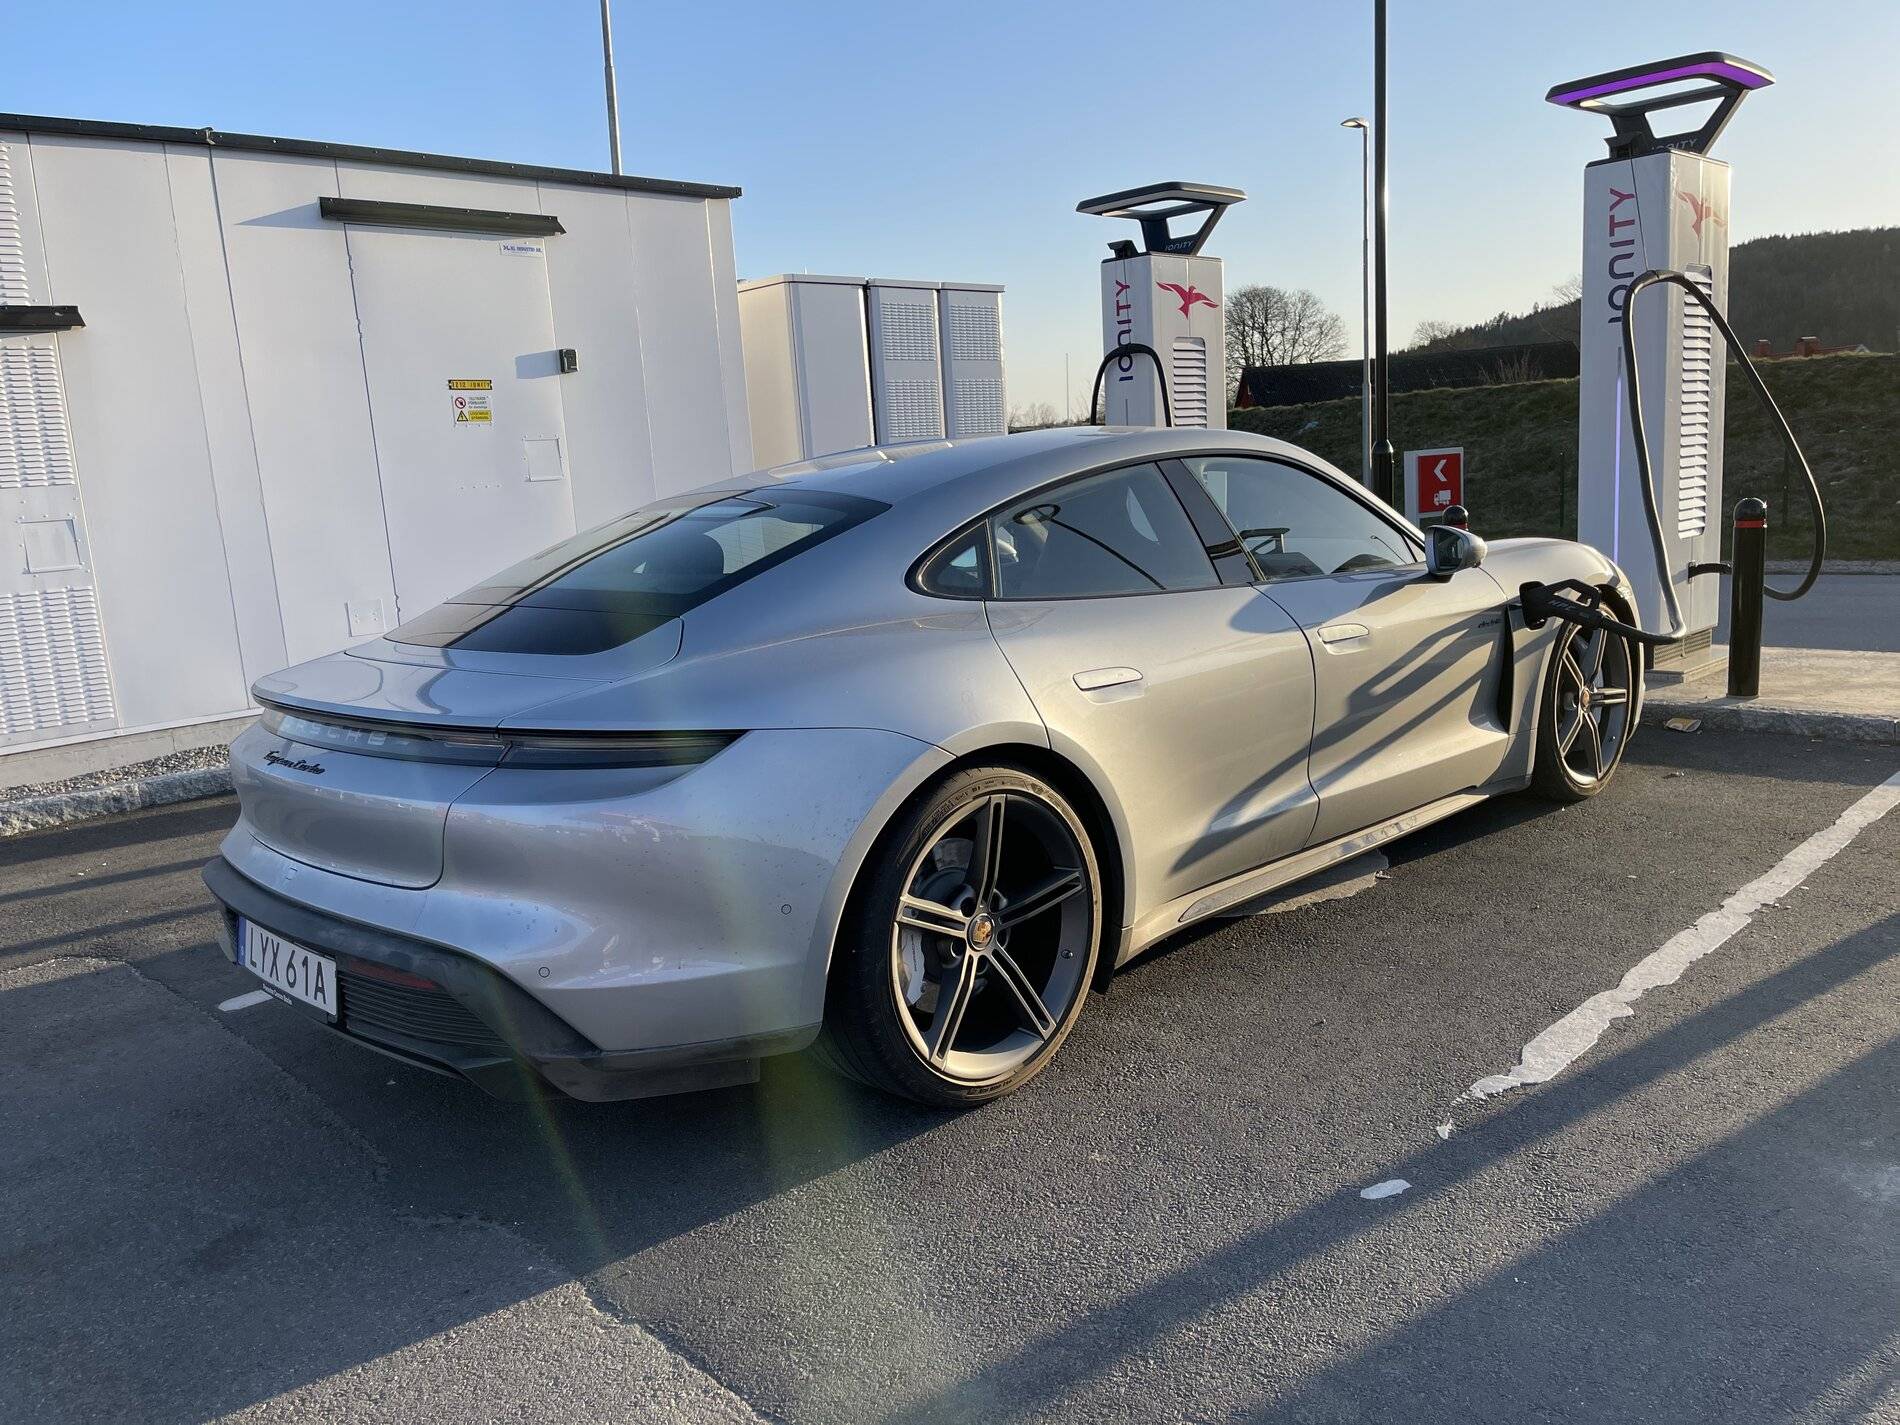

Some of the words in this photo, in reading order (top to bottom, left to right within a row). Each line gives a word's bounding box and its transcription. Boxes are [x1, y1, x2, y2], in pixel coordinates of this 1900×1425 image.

[1651, 138, 1697, 150] NITY
[1165, 240, 1194, 251] IONITY
[1115, 279, 1134, 382] IONITY
[293, 759, 326, 775] Turbo
[250, 927, 280, 982] LYX
[286, 949, 327, 1005] 61A
